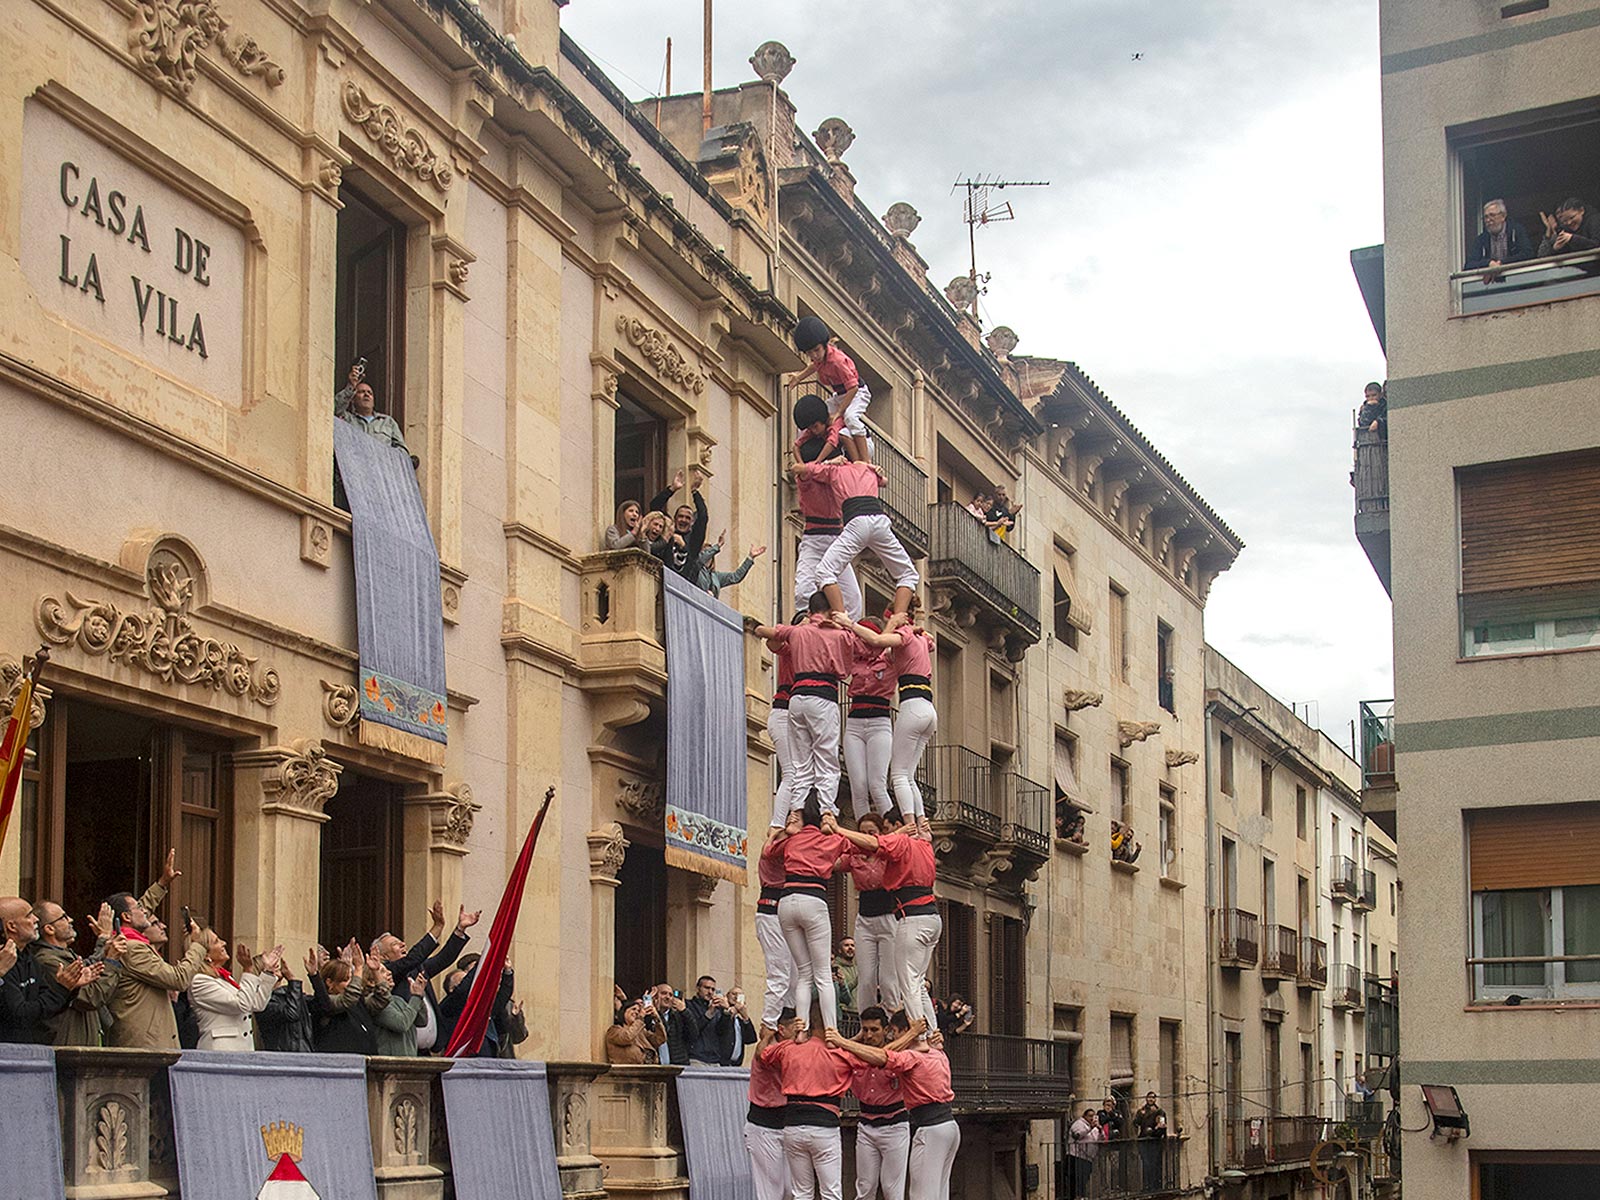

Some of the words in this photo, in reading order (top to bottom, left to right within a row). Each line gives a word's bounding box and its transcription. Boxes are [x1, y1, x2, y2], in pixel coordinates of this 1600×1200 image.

[60, 161, 152, 253] CASA
[174, 227, 211, 287] DE
[59, 234, 105, 303] LA
[131, 275, 209, 360] VILA
